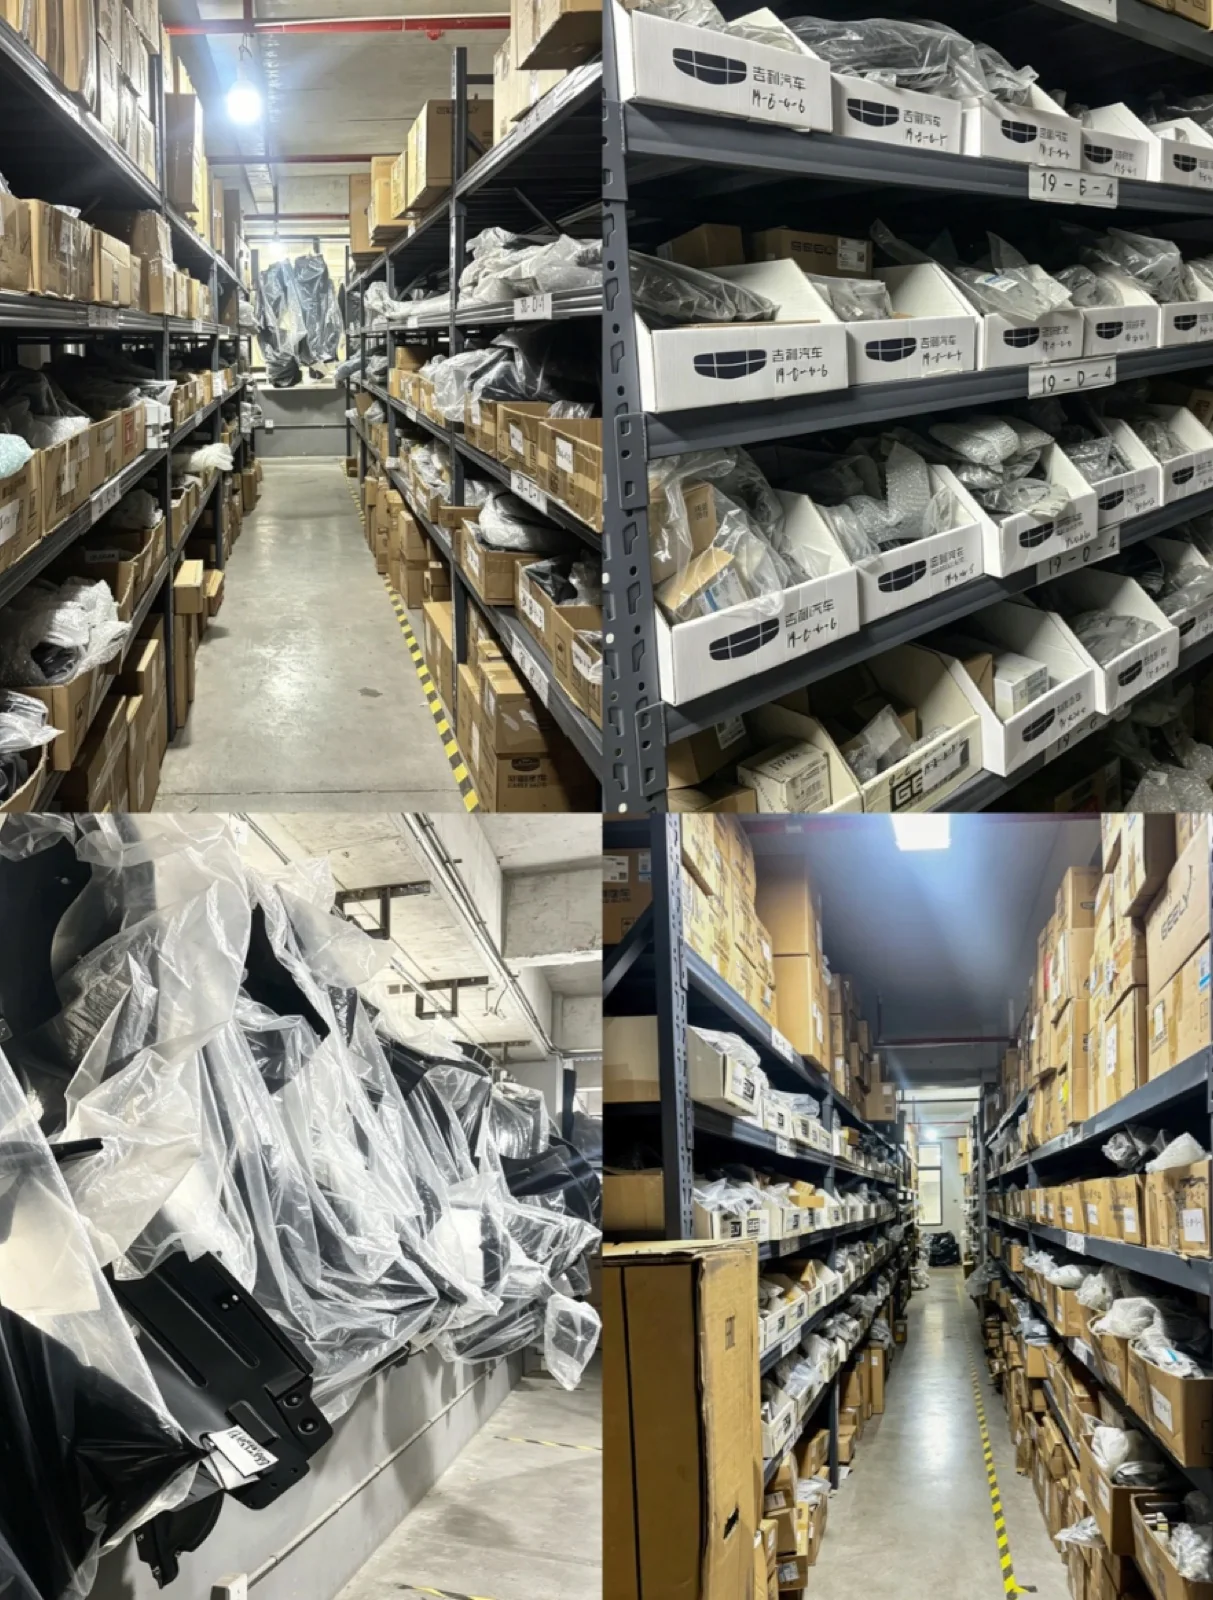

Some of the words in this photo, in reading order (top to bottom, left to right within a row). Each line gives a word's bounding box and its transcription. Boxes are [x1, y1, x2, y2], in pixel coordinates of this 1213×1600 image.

[752, 65, 806, 90] 吉利汽车
[772, 346, 823, 363] 吉利汽车
[785, 598, 835, 628] 吉利汽车
